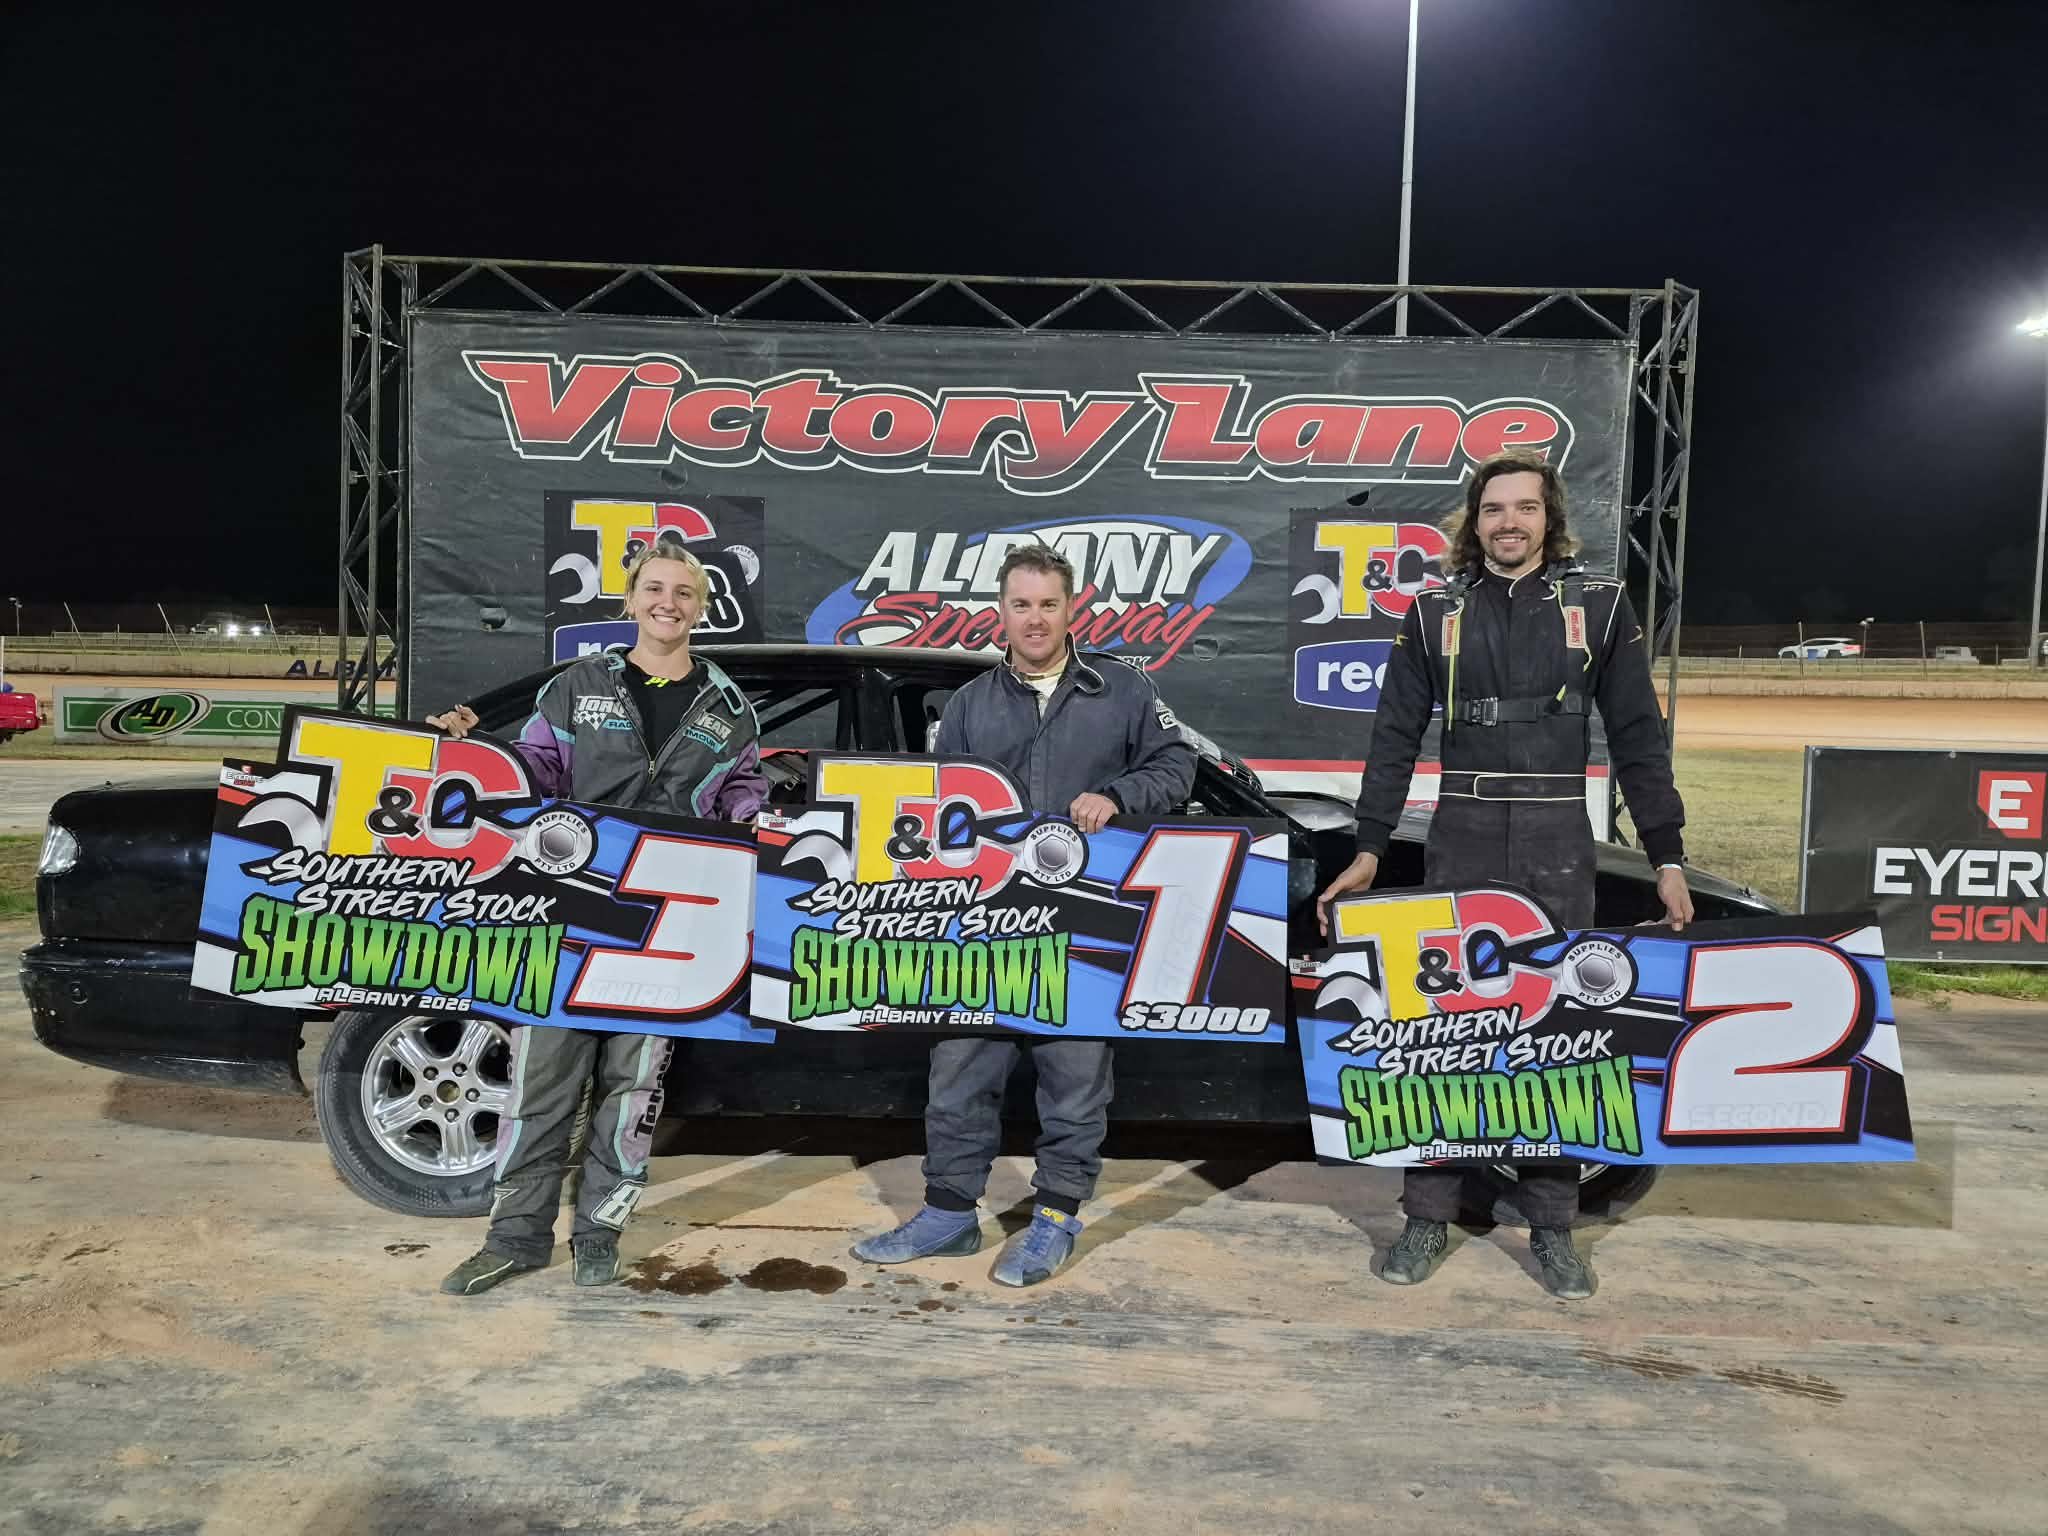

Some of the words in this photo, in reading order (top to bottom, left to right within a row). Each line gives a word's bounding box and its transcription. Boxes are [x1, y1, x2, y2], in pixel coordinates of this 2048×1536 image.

[462, 350, 1158, 496] Victory
[1137, 372, 1574, 485] Lane
[834, 583, 1215, 671] Speway
[286, 659, 397, 678] ALB
[226, 709, 281, 729] CON
[608, 720, 632, 729] RAC
[288, 716, 531, 885] T&C
[1989, 780, 2033, 829] E
[535, 813, 588, 834] SUPPLIES
[815, 757, 1022, 901] T&C
[1030, 824, 1078, 842] SUPPLIES
[268, 849, 471, 888] SOUTHERN
[534, 857, 553, 872] PTY
[557, 861, 576, 873] LTD
[1033, 868, 1052, 882] PTY
[1055, 870, 1072, 882] LTD
[1874, 847, 2048, 898] EYER
[294, 883, 440, 918] STREET
[442, 889, 557, 924] STOCK
[809, 878, 981, 914] SOUTHERN
[565, 834, 758, 1015] 3
[834, 910, 955, 942] STREET
[960, 905, 1059, 937] STOCK
[1122, 830, 1241, 1008] 1
[1930, 905, 2048, 943] SIGN
[233, 896, 565, 1017] SHOWDOWN
[1333, 889, 1555, 1030] T&C
[1568, 942, 1622, 963] SUPPLIES
[791, 927, 1070, 1026] SHOWDOWN
[316, 987, 416, 1007] ALBANY
[418, 997, 473, 1012] 2026
[1578, 990, 1599, 1004] PTY
[1603, 989, 1622, 1003] LTD
[861, 1009, 945, 1024] ALBANY
[948, 1010, 996, 1025] 2026
[1121, 1002, 1271, 1033] $3000
[1349, 1006, 1520, 1054] SOUTHERN
[1378, 1041, 1501, 1080] STREET
[1508, 1029, 1614, 1071] STOCK
[1663, 942, 1861, 1136] 2
[1341, 1056, 1642, 1158] SHOWDOWN
[1419, 1143, 1506, 1159] ALBANY
[1512, 1143, 1561, 1159] 2026
